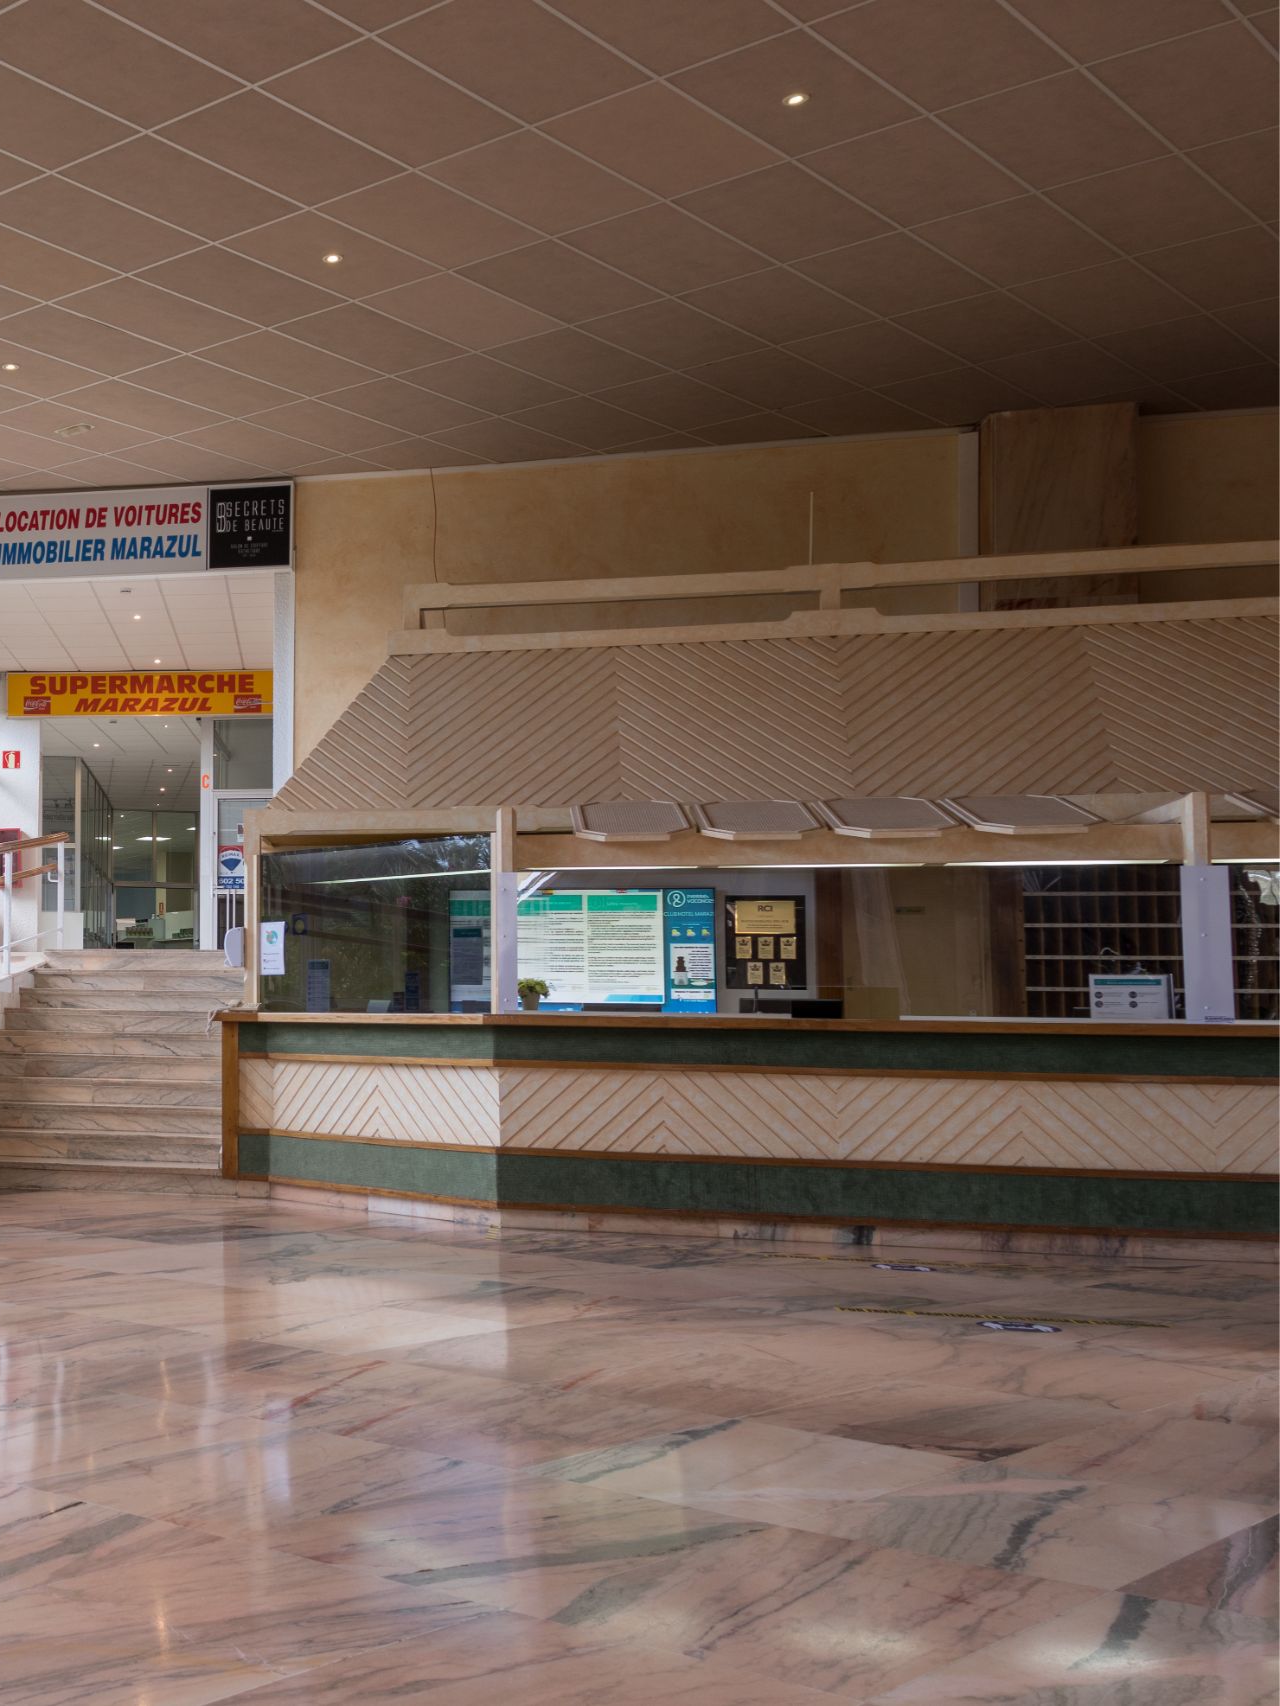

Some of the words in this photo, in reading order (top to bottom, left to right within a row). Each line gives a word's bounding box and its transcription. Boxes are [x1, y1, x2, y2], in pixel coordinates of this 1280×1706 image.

[85, 507, 108, 528] DE
[113, 501, 202, 528] VOITURES
[226, 499, 285, 518] SECRETS
[226, 520, 238, 533] DE
[110, 534, 202, 560] MARAZUL
[30, 674, 254, 695] SUPERMARCHE
[74, 697, 212, 713] MARAZUL
[202, 774, 209, 789] C
